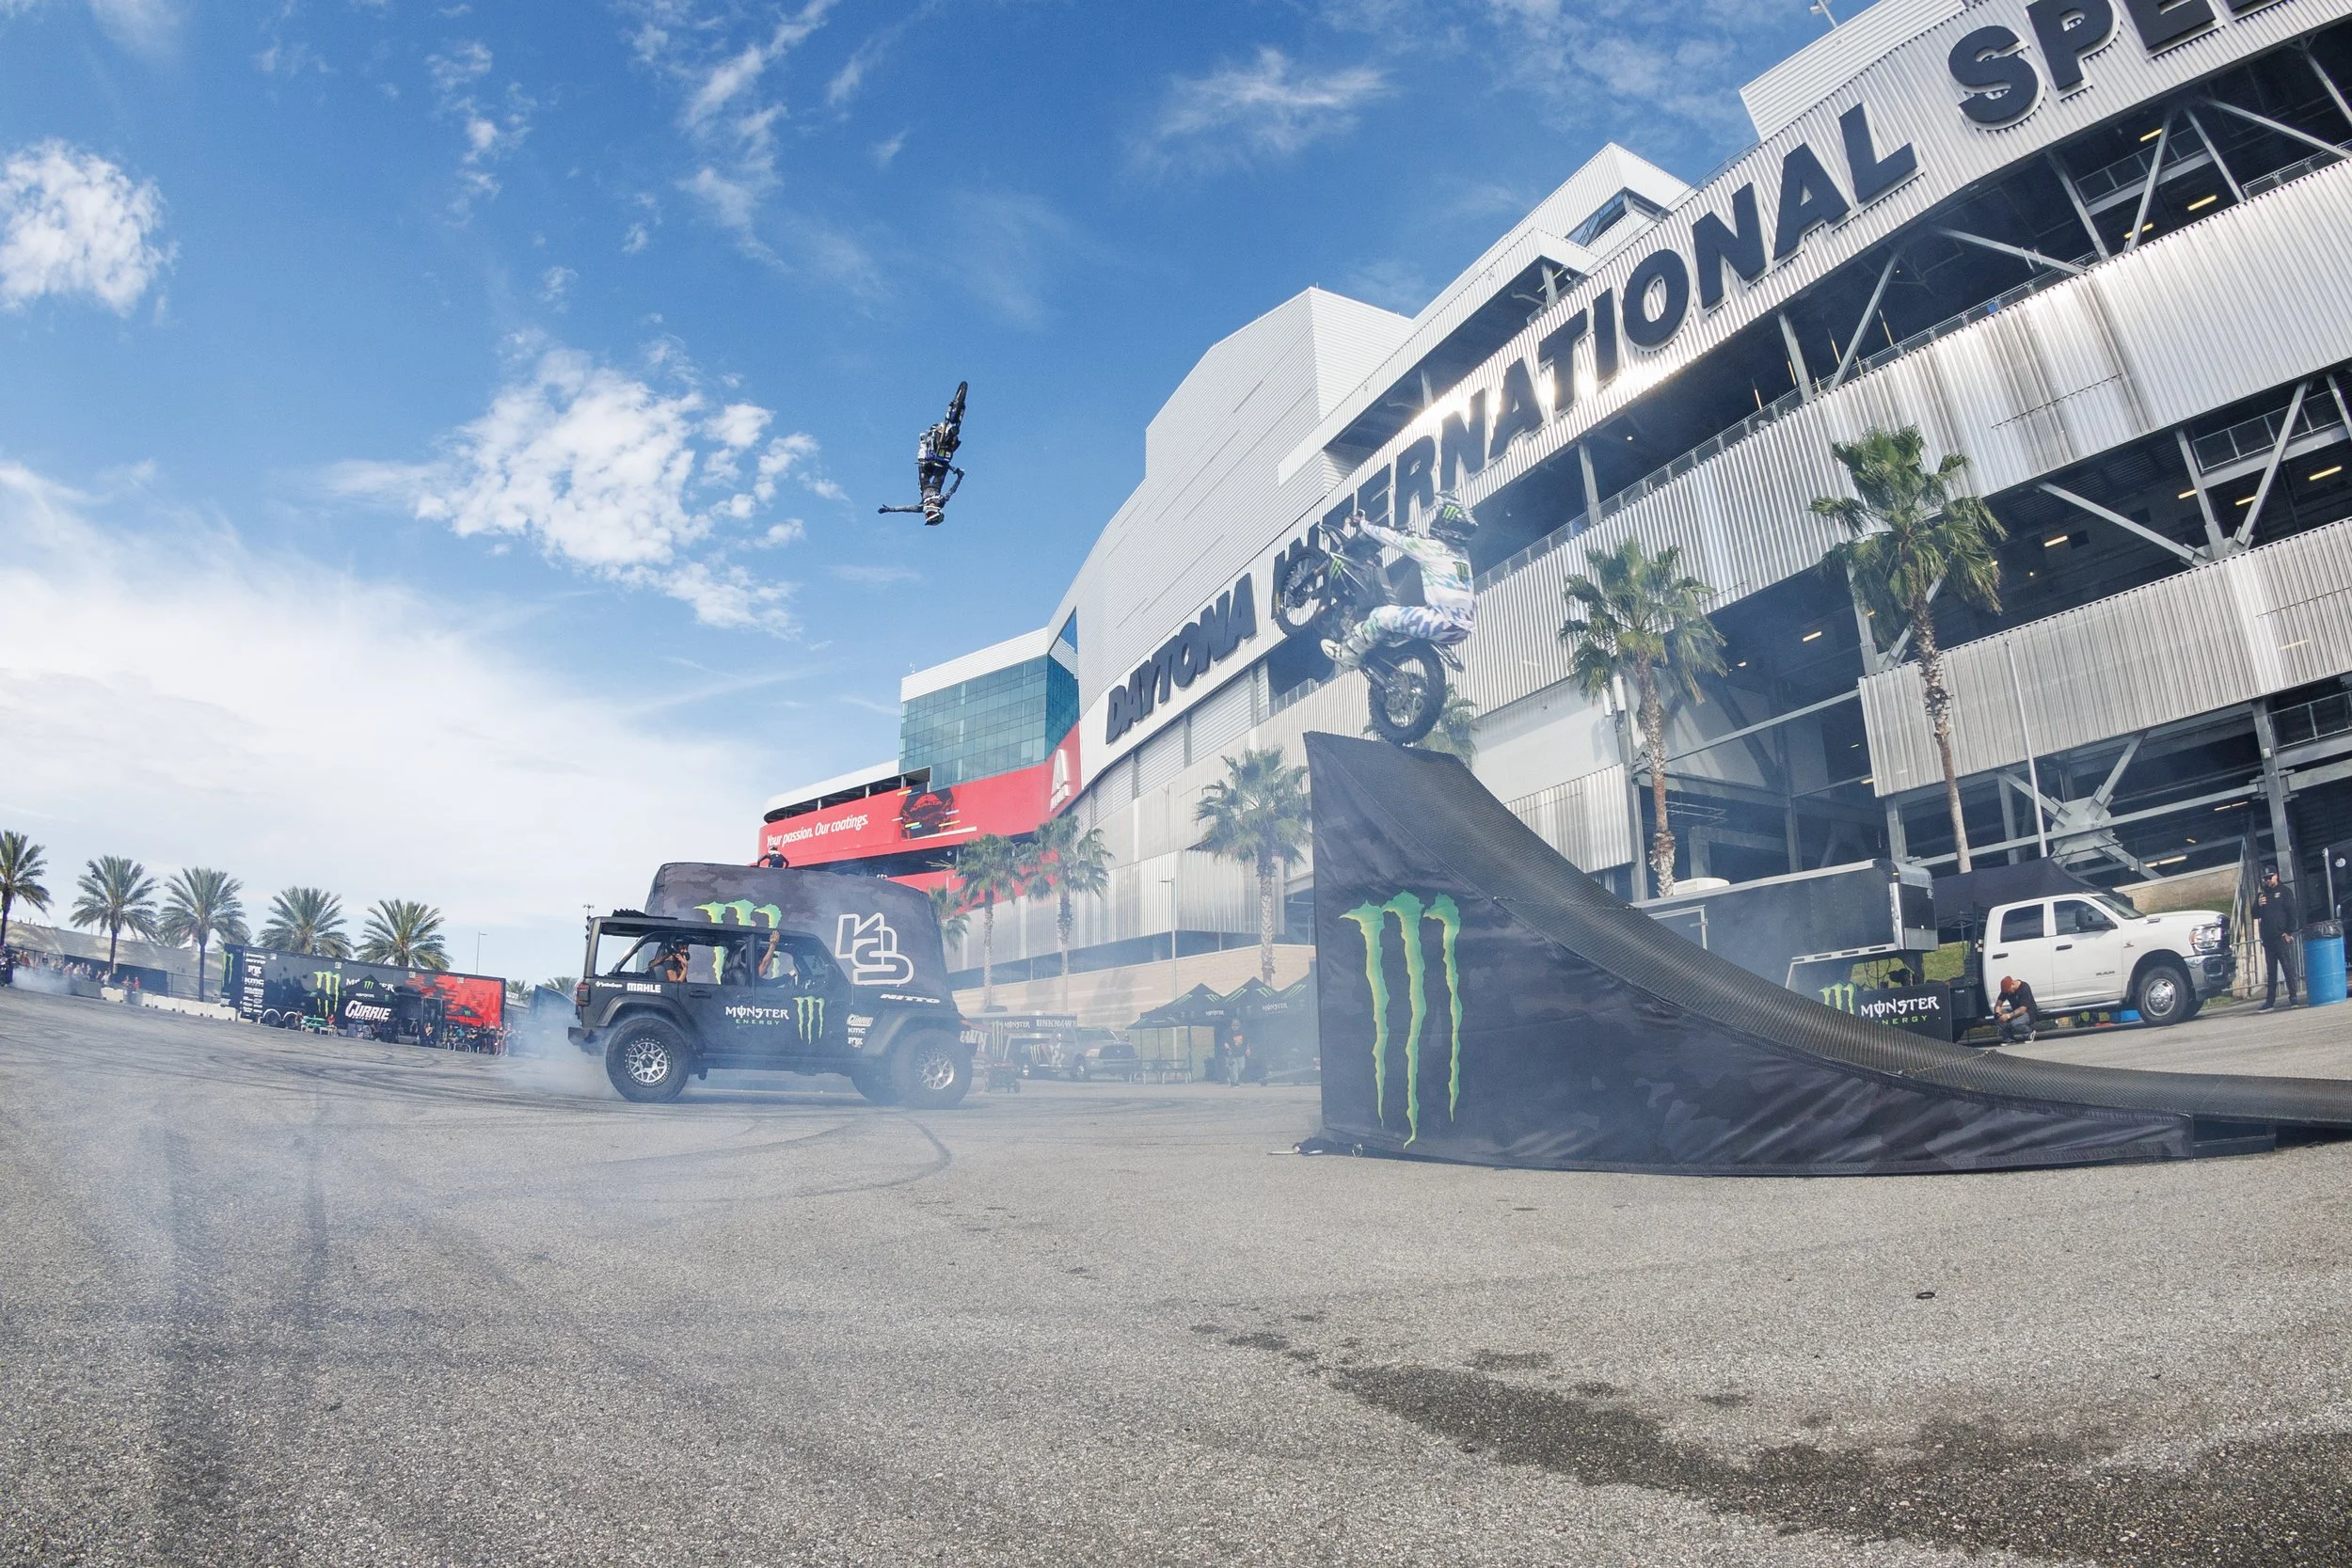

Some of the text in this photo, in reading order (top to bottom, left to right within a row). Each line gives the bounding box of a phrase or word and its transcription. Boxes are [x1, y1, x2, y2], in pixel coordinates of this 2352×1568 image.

[1105, 572, 1257, 745] DAYTONA
[767, 814, 869, 847] Your passion. Our coatings.
[627, 982, 661, 993] MAHLE
[881, 993, 941, 1004] NITTO
[345, 1000, 391, 1021] CURRIE
[725, 1005, 790, 1020] MONSTER
[1860, 996, 1941, 1018] MONSTER
[735, 1018, 781, 1026] ENERGY
[1875, 1015, 1929, 1025] NERGY
